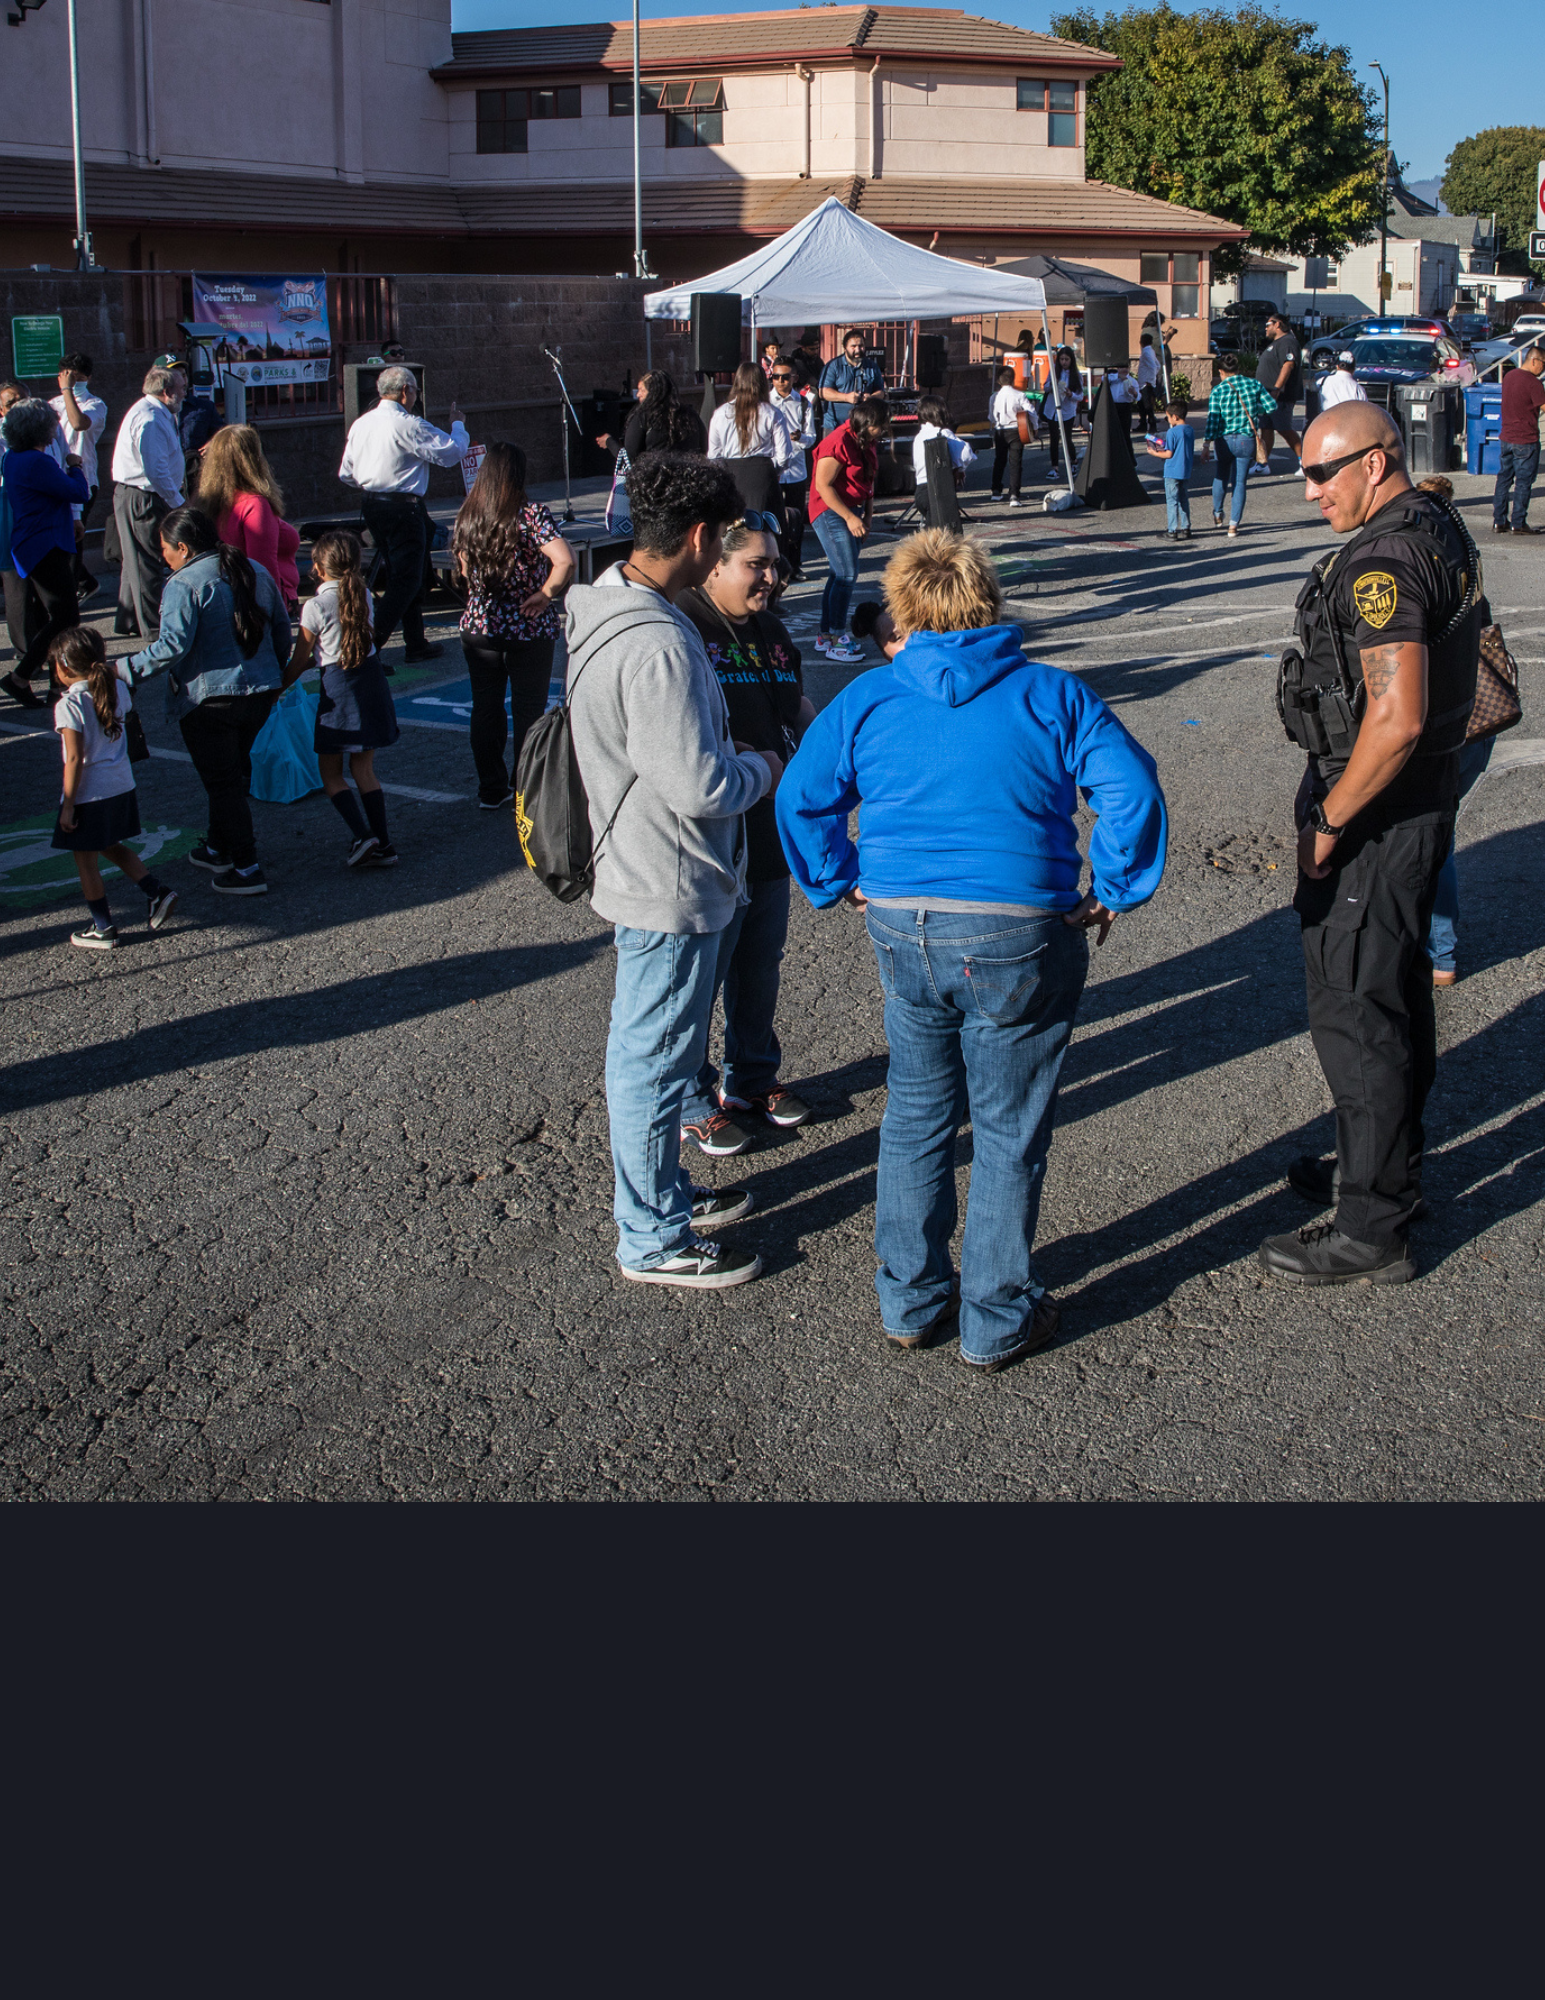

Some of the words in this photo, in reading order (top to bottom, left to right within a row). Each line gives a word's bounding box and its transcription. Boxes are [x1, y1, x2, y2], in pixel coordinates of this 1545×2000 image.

[214, 285, 245, 294] Tuesday
[203, 294, 231, 302] October
[241, 294, 257, 302] 2022
[288, 293, 313, 308] NNO
[264, 368, 288, 376] PARKS
[464, 457, 475, 467] NO
[715, 669, 771, 684] Gratel
[774, 669, 798, 683] Dead
